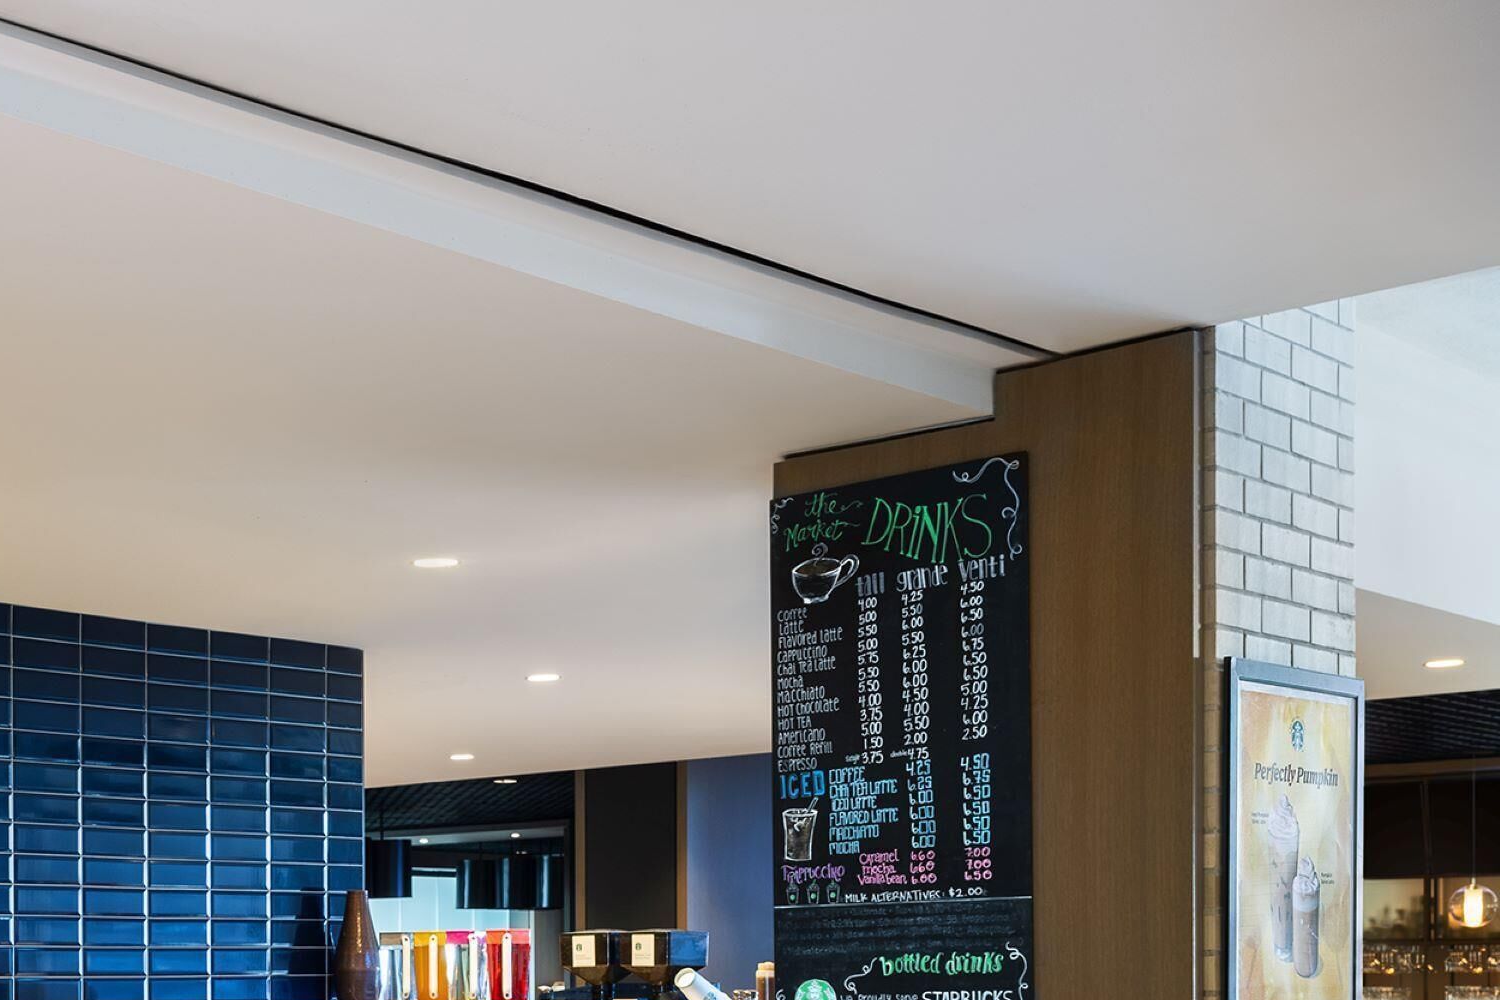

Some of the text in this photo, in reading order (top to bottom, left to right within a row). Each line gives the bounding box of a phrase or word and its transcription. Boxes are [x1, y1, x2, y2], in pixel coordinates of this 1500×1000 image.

[856, 554, 1006, 596] tall grande venti
[780, 770, 826, 800] ICED
[829, 766, 866, 784] COFFEE
[1255, 763, 1338, 789] Perfectly Pumpkin
[845, 893, 868, 903] MILK
[948, 886, 983, 898] $2.00
[879, 952, 1004, 976] bottled drinks
